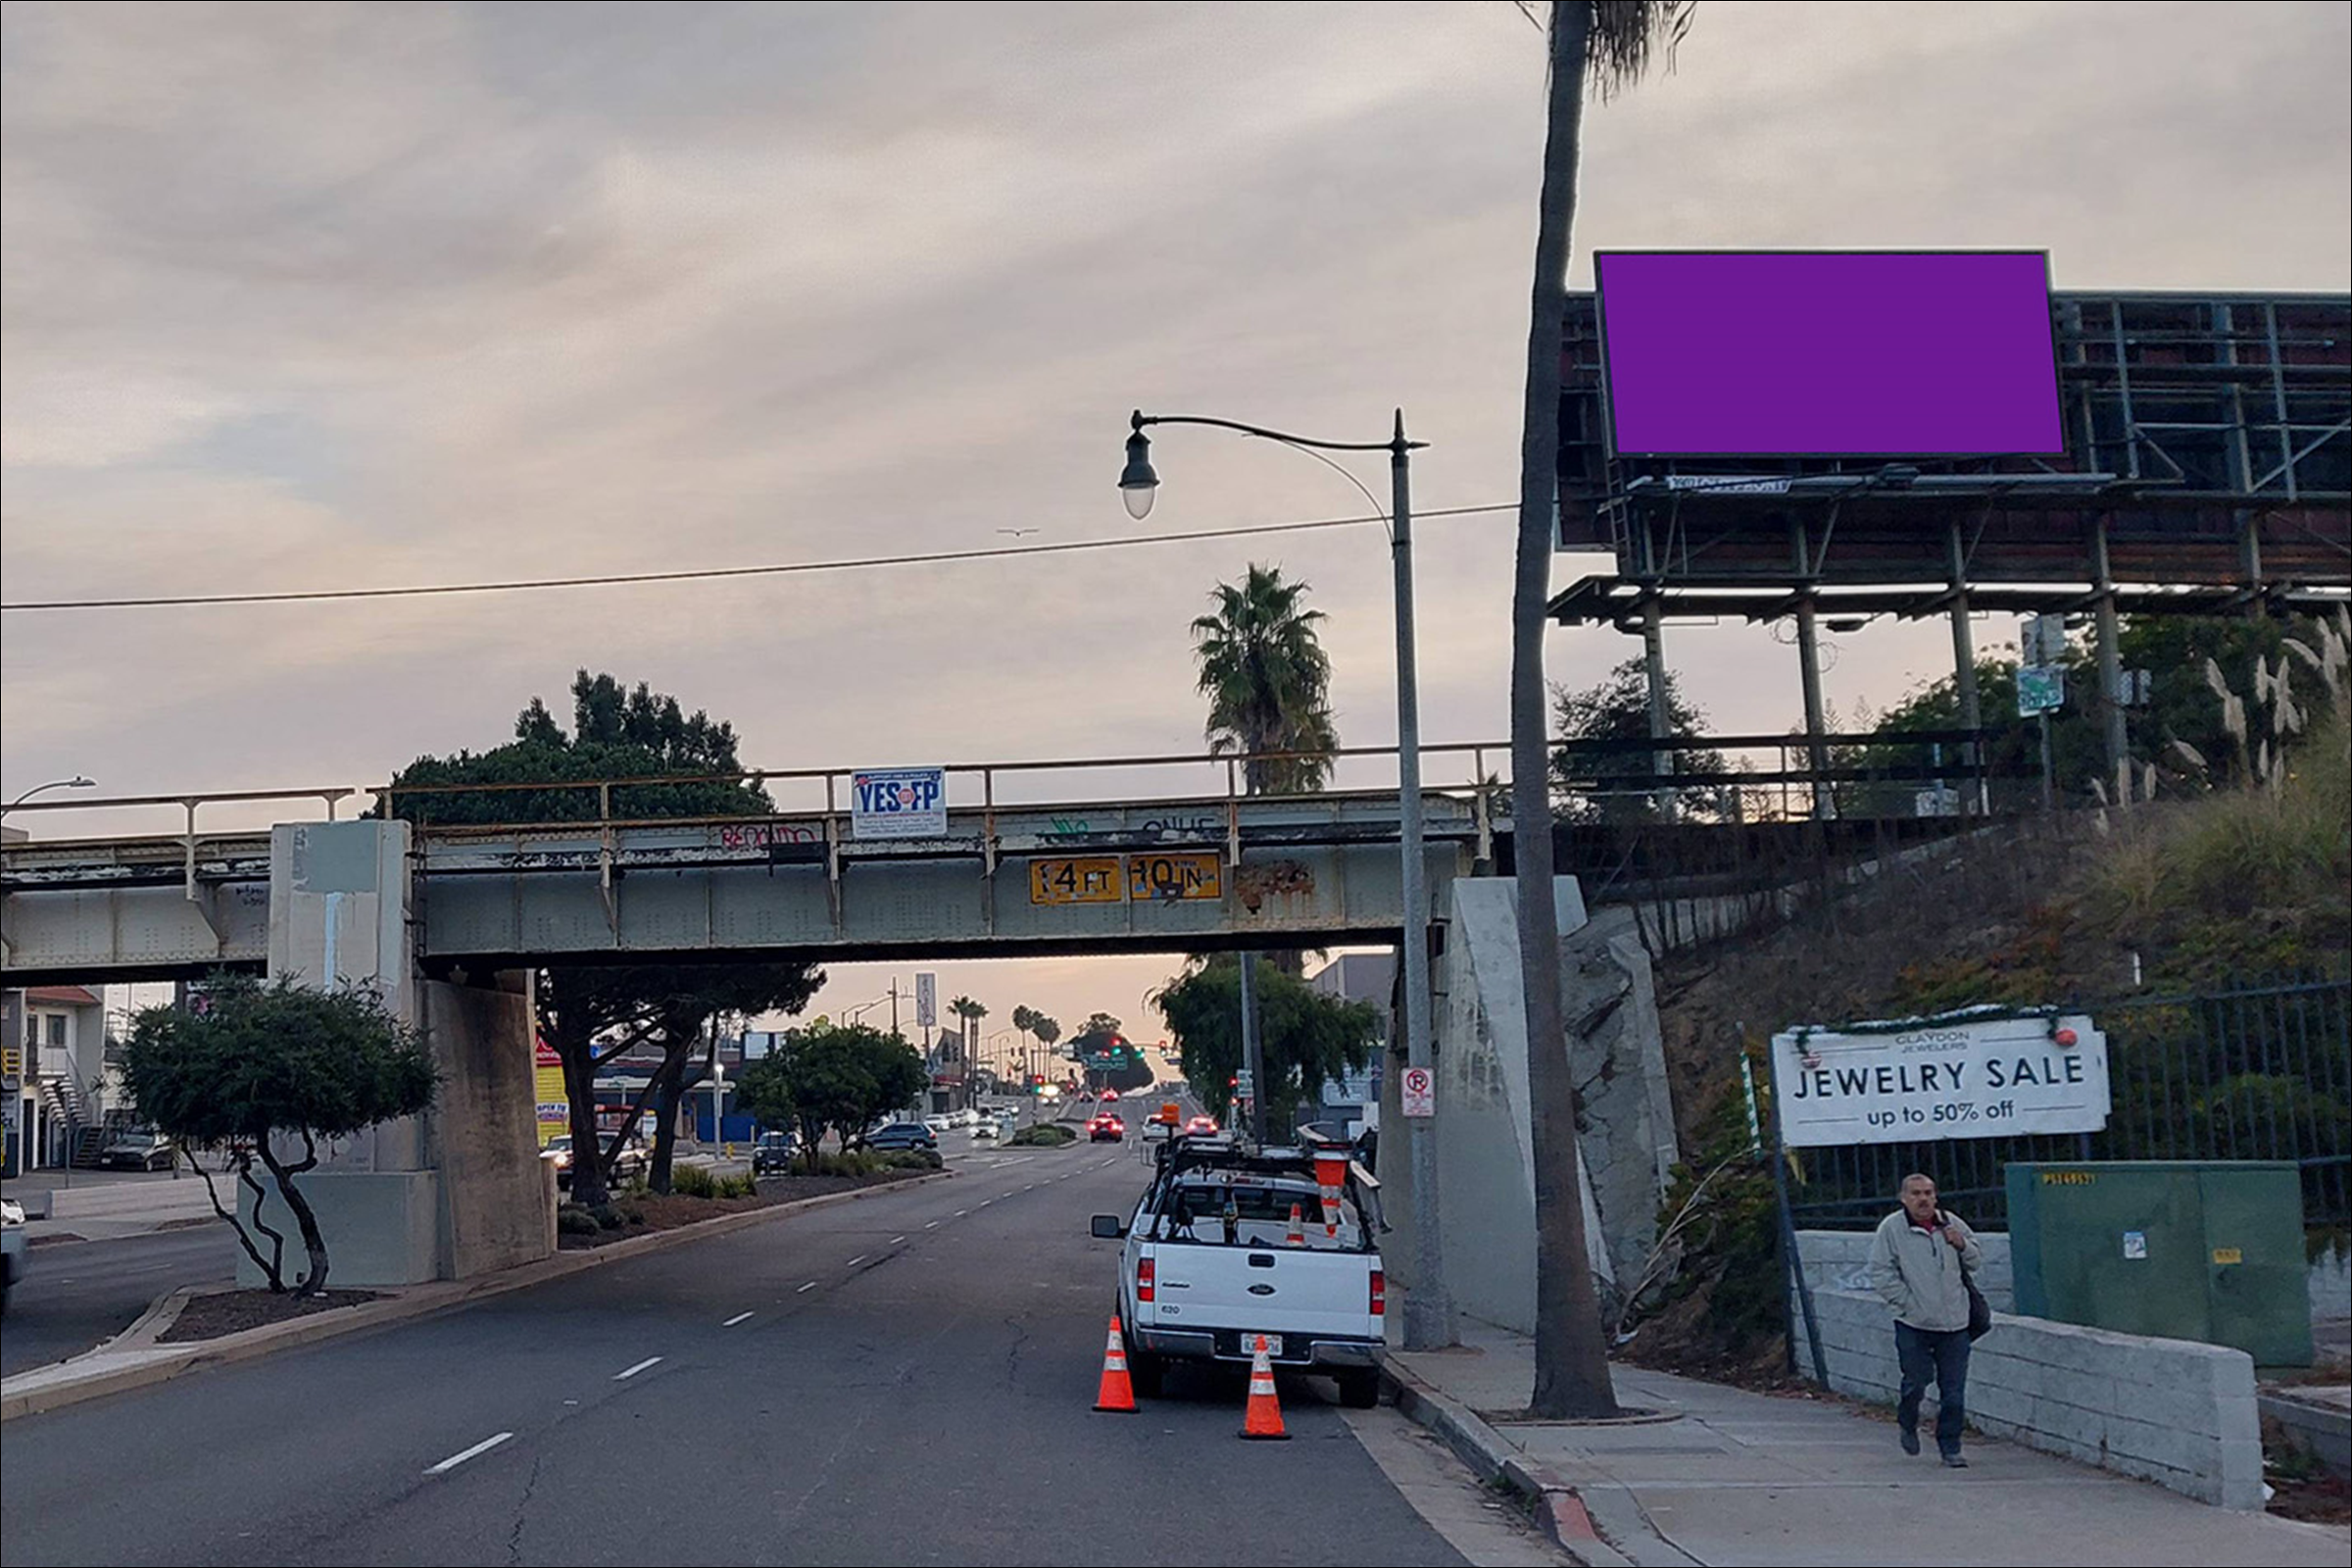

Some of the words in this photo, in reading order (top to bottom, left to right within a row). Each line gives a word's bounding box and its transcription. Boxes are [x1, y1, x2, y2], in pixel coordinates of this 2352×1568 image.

[858, 782, 902, 812] YES
[910, 781, 939, 810] FP
[1084, 870, 1110, 892] FT
[1895, 1031, 1970, 1046] CLAYDON
[1901, 1042, 1968, 1054] JEWELERS
[1793, 1061, 1966, 1100] JEWELRY
[1986, 1054, 2084, 1089] SALE
[1867, 1108, 1896, 1129] up
[1903, 1105, 1925, 1125] to
[1933, 1102, 1980, 1123] 50%
[1985, 1100, 2015, 1119] off
